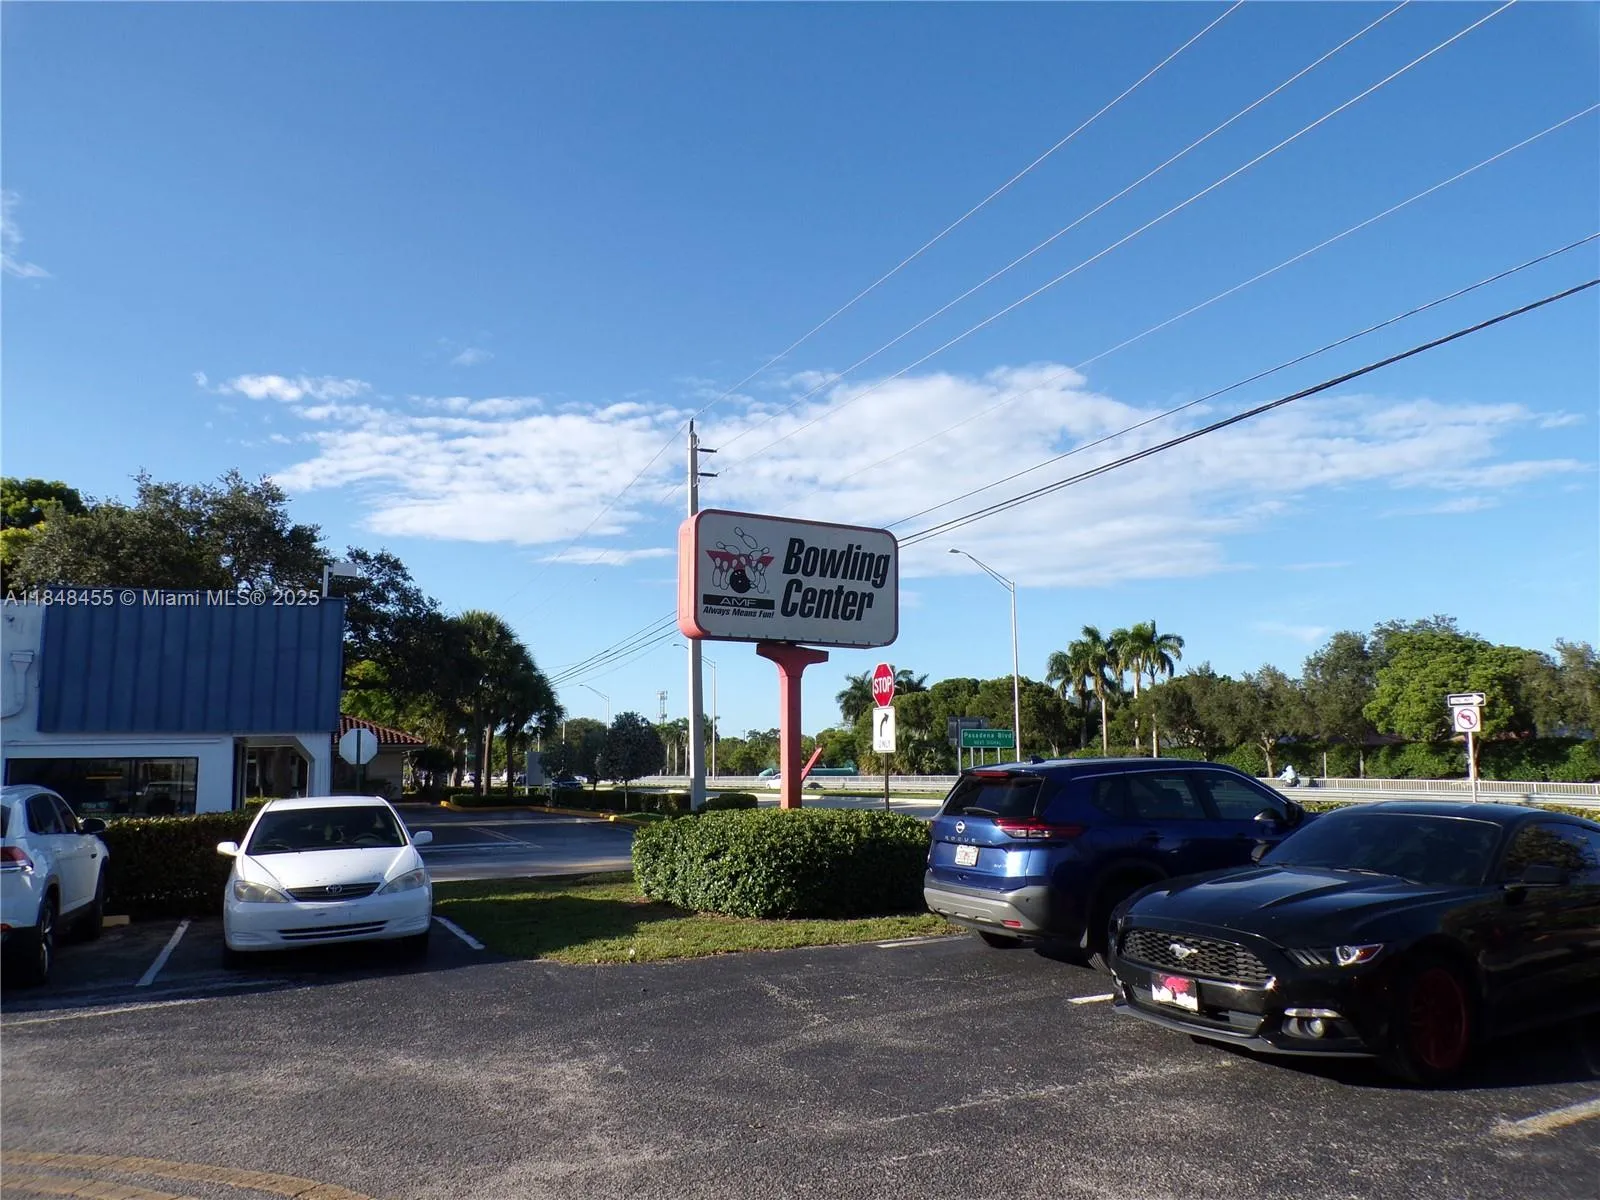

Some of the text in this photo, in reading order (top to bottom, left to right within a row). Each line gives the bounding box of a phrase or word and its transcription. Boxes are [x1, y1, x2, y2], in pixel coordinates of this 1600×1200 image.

[782, 537, 891, 589] Bowling
[720, 597, 757, 607] AMF
[781, 578, 875, 622] Center
[703, 606, 775, 619] Always Means Fun!
[874, 677, 892, 694] STOP
